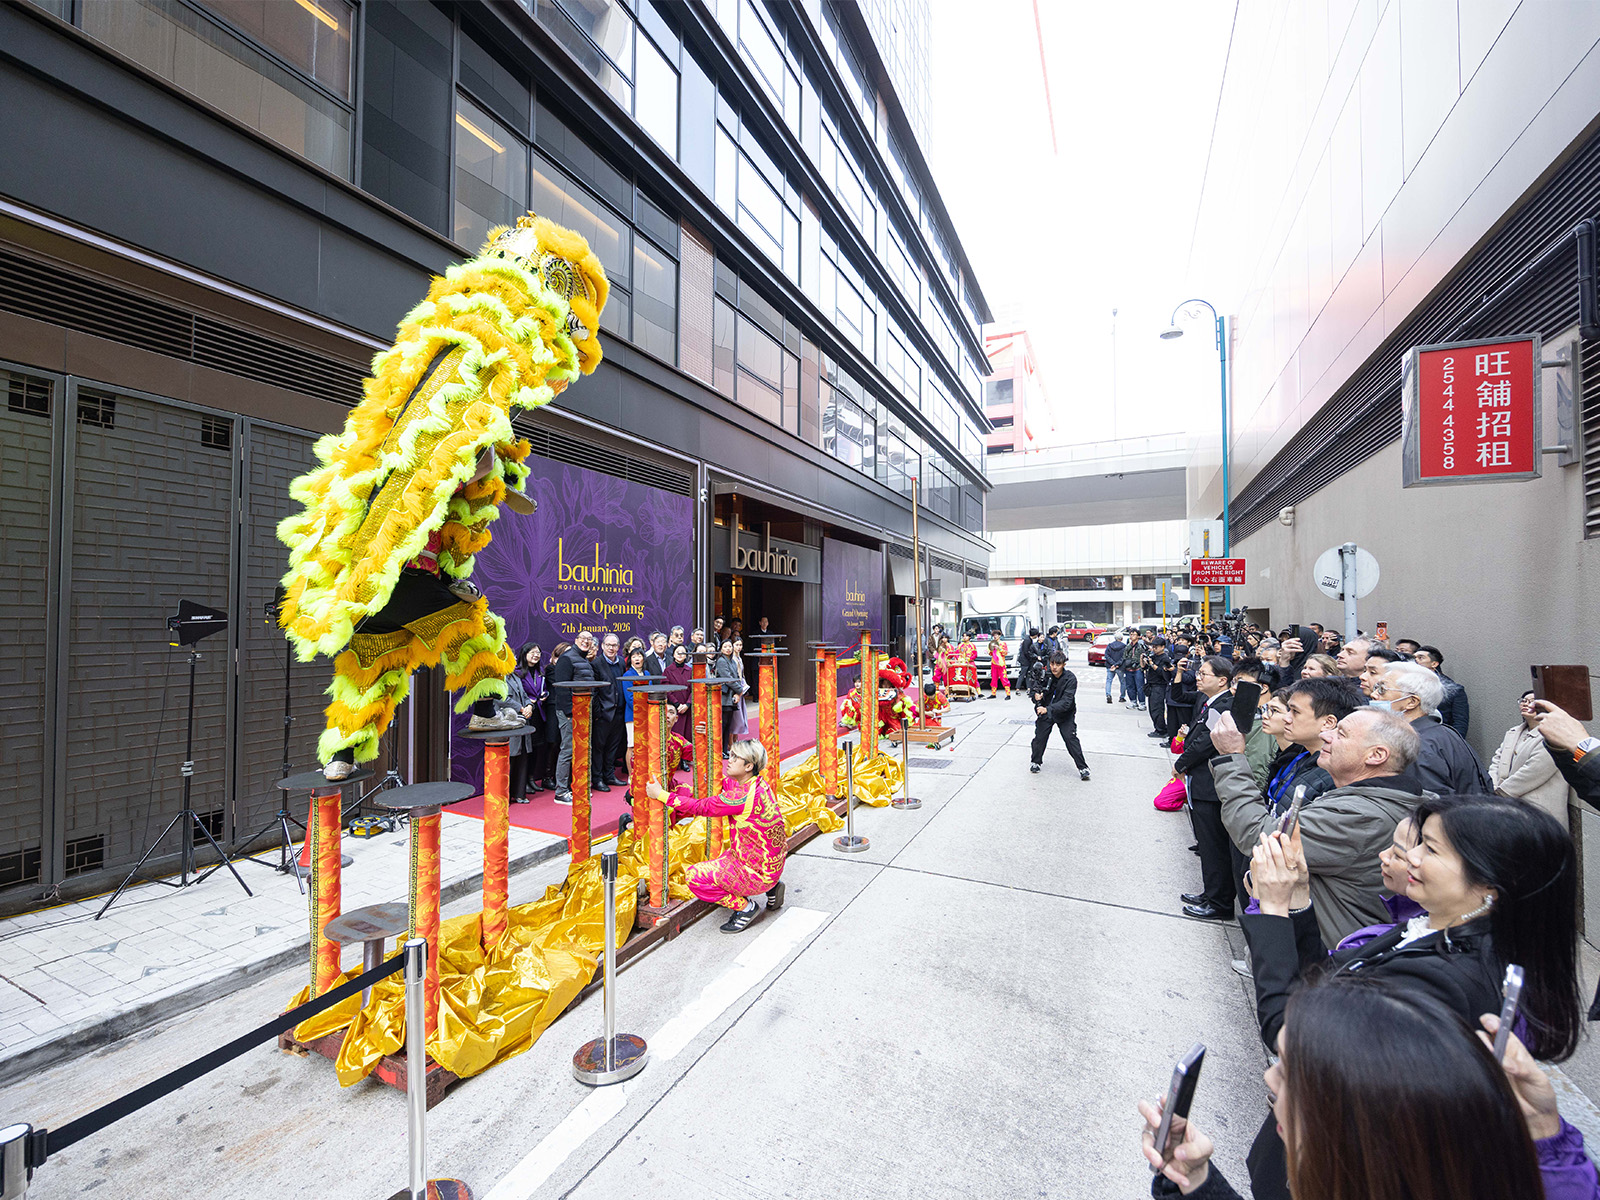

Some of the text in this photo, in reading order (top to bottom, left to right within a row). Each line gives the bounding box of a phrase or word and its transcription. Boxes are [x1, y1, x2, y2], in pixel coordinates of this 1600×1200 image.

[1475, 351, 1512, 468] 旺舖招租
[558, 537, 633, 585] bauhinia
[732, 513, 798, 576] bauhinia
[543, 595, 645, 620] Grand Opening
[561, 622, 576, 633] 7th
[612, 622, 631, 632] 2026
